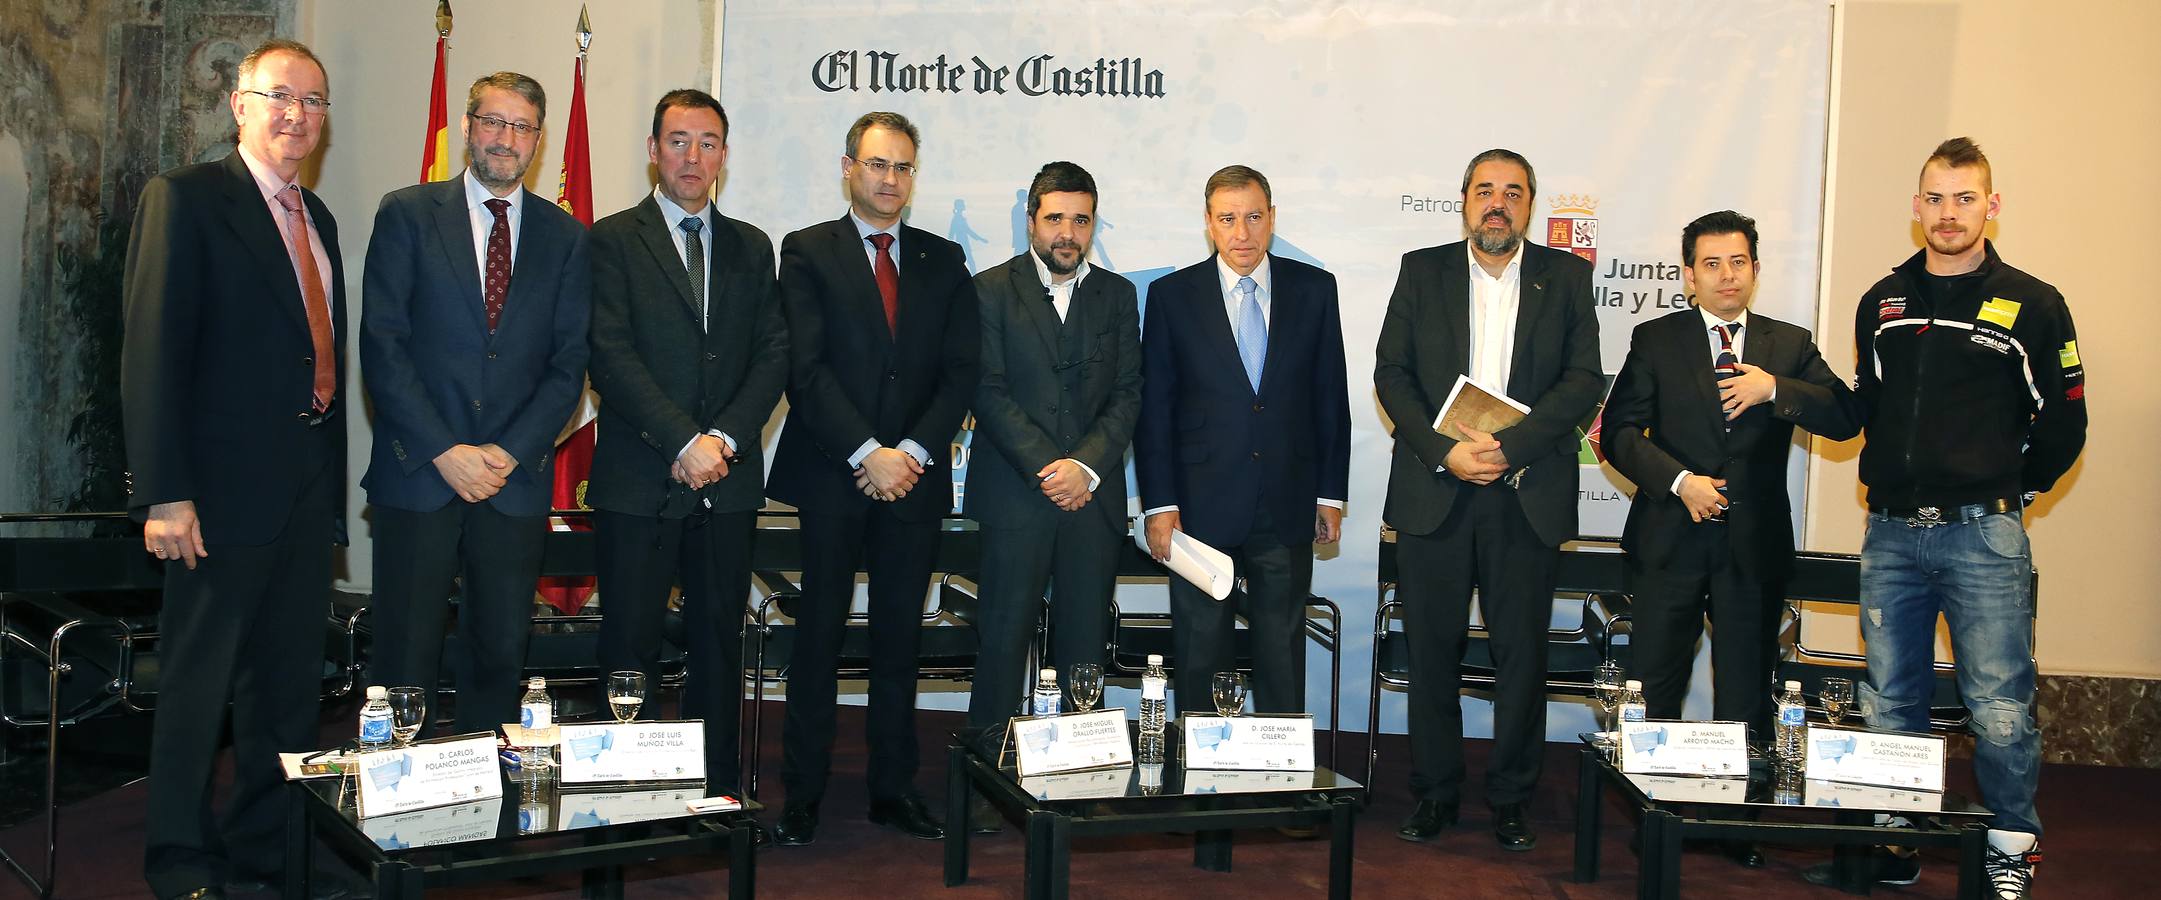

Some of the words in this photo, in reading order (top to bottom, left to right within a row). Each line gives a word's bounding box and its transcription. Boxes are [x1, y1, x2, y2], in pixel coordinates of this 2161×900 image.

[811, 50, 859, 93] El
[865, 50, 966, 94] Norte
[971, 55, 1010, 95] de
[1016, 54, 1166, 99] Castilla
[1604, 259, 1680, 281] Junta
[1631, 292, 1648, 314] y
[449, 748, 474, 759] CARLOS
[1903, 744, 1931, 752] MANUEL
[425, 760, 459, 771] POLANCO
[460, 755, 490, 766] MANGAS
